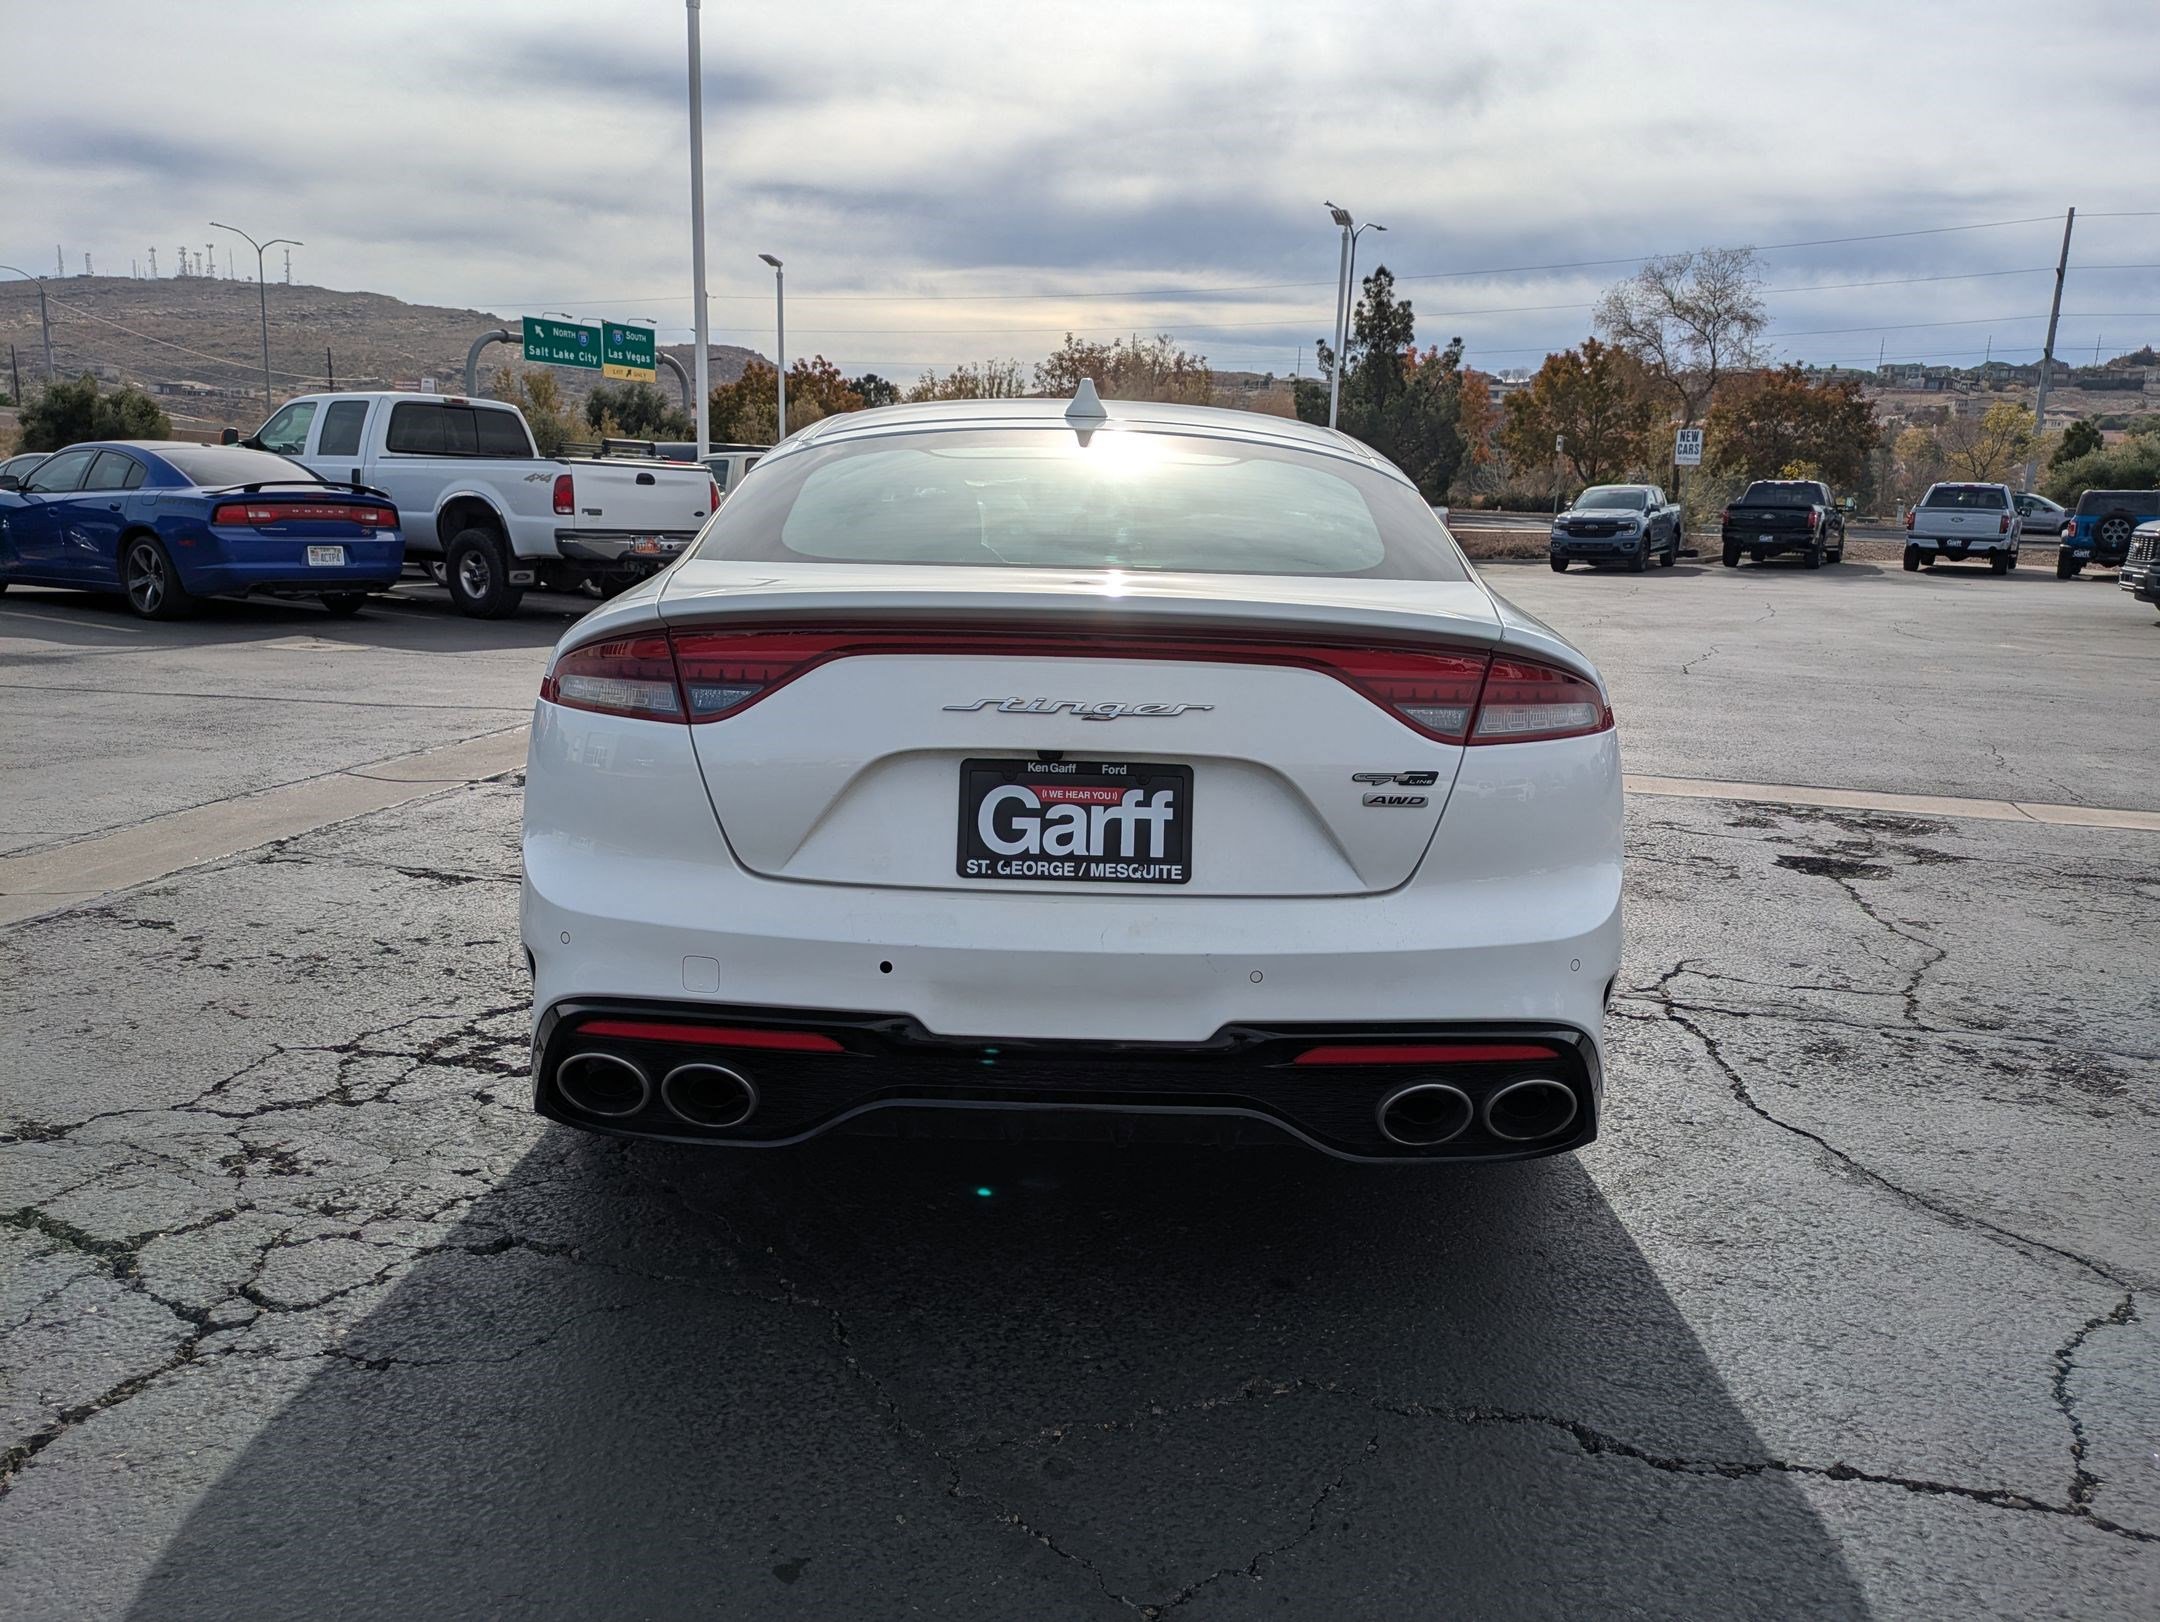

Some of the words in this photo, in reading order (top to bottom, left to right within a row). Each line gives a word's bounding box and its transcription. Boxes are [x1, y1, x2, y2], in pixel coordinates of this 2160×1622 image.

[553, 327, 576, 339] NORTH
[625, 330, 647, 342] SOUTH
[529, 345, 549, 357] Salt
[553, 348, 575, 360] Lake
[578, 351, 598, 365] City
[608, 348, 623, 360] Las
[626, 350, 651, 364] Vegas
[1680, 430, 1699, 443] NEW
[1677, 443, 1700, 455] CARS
[1027, 762, 1049, 773] Ken
[1050, 763, 1077, 774] Garff
[1102, 764, 1127, 775] Ford
[1049, 790, 1063, 799] WE
[1065, 790, 1091, 799] HEAR
[1092, 791, 1112, 800] YOU
[1367, 796, 1426, 805] AWD
[977, 784, 1174, 858] Garff
[966, 860, 992, 874] ST.
[997, 860, 1075, 877] GEORGE
[1090, 863, 1183, 879] MESQUITE
